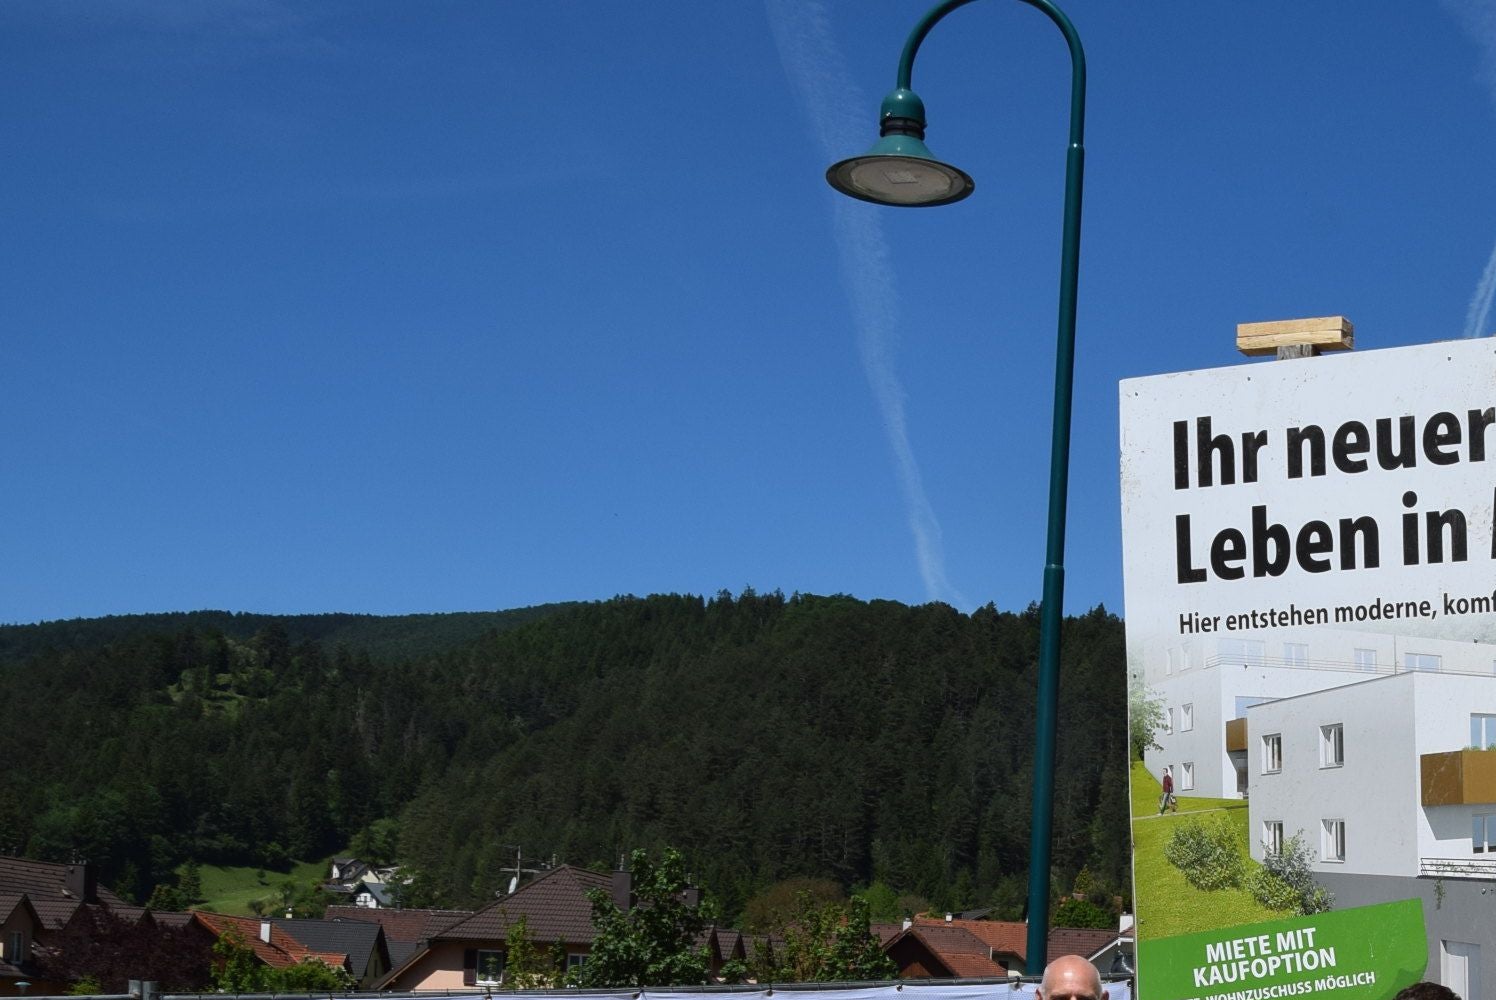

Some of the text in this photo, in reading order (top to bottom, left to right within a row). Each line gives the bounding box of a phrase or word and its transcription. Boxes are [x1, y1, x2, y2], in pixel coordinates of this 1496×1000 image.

[1173, 411, 1268, 490] Ihr
[1286, 406, 1496, 480] neuer
[1175, 506, 1381, 585] Leben
[1401, 491, 1468, 566] in
[1179, 609, 1222, 635] Hier
[1225, 604, 1329, 632] entstehen
[1335, 598, 1437, 624] moderne,
[1206, 927, 1316, 964] MIETE MIT
[1193, 947, 1336, 988] KAUFOPTION
[1315, 972, 1375, 992] MÖGLICH
